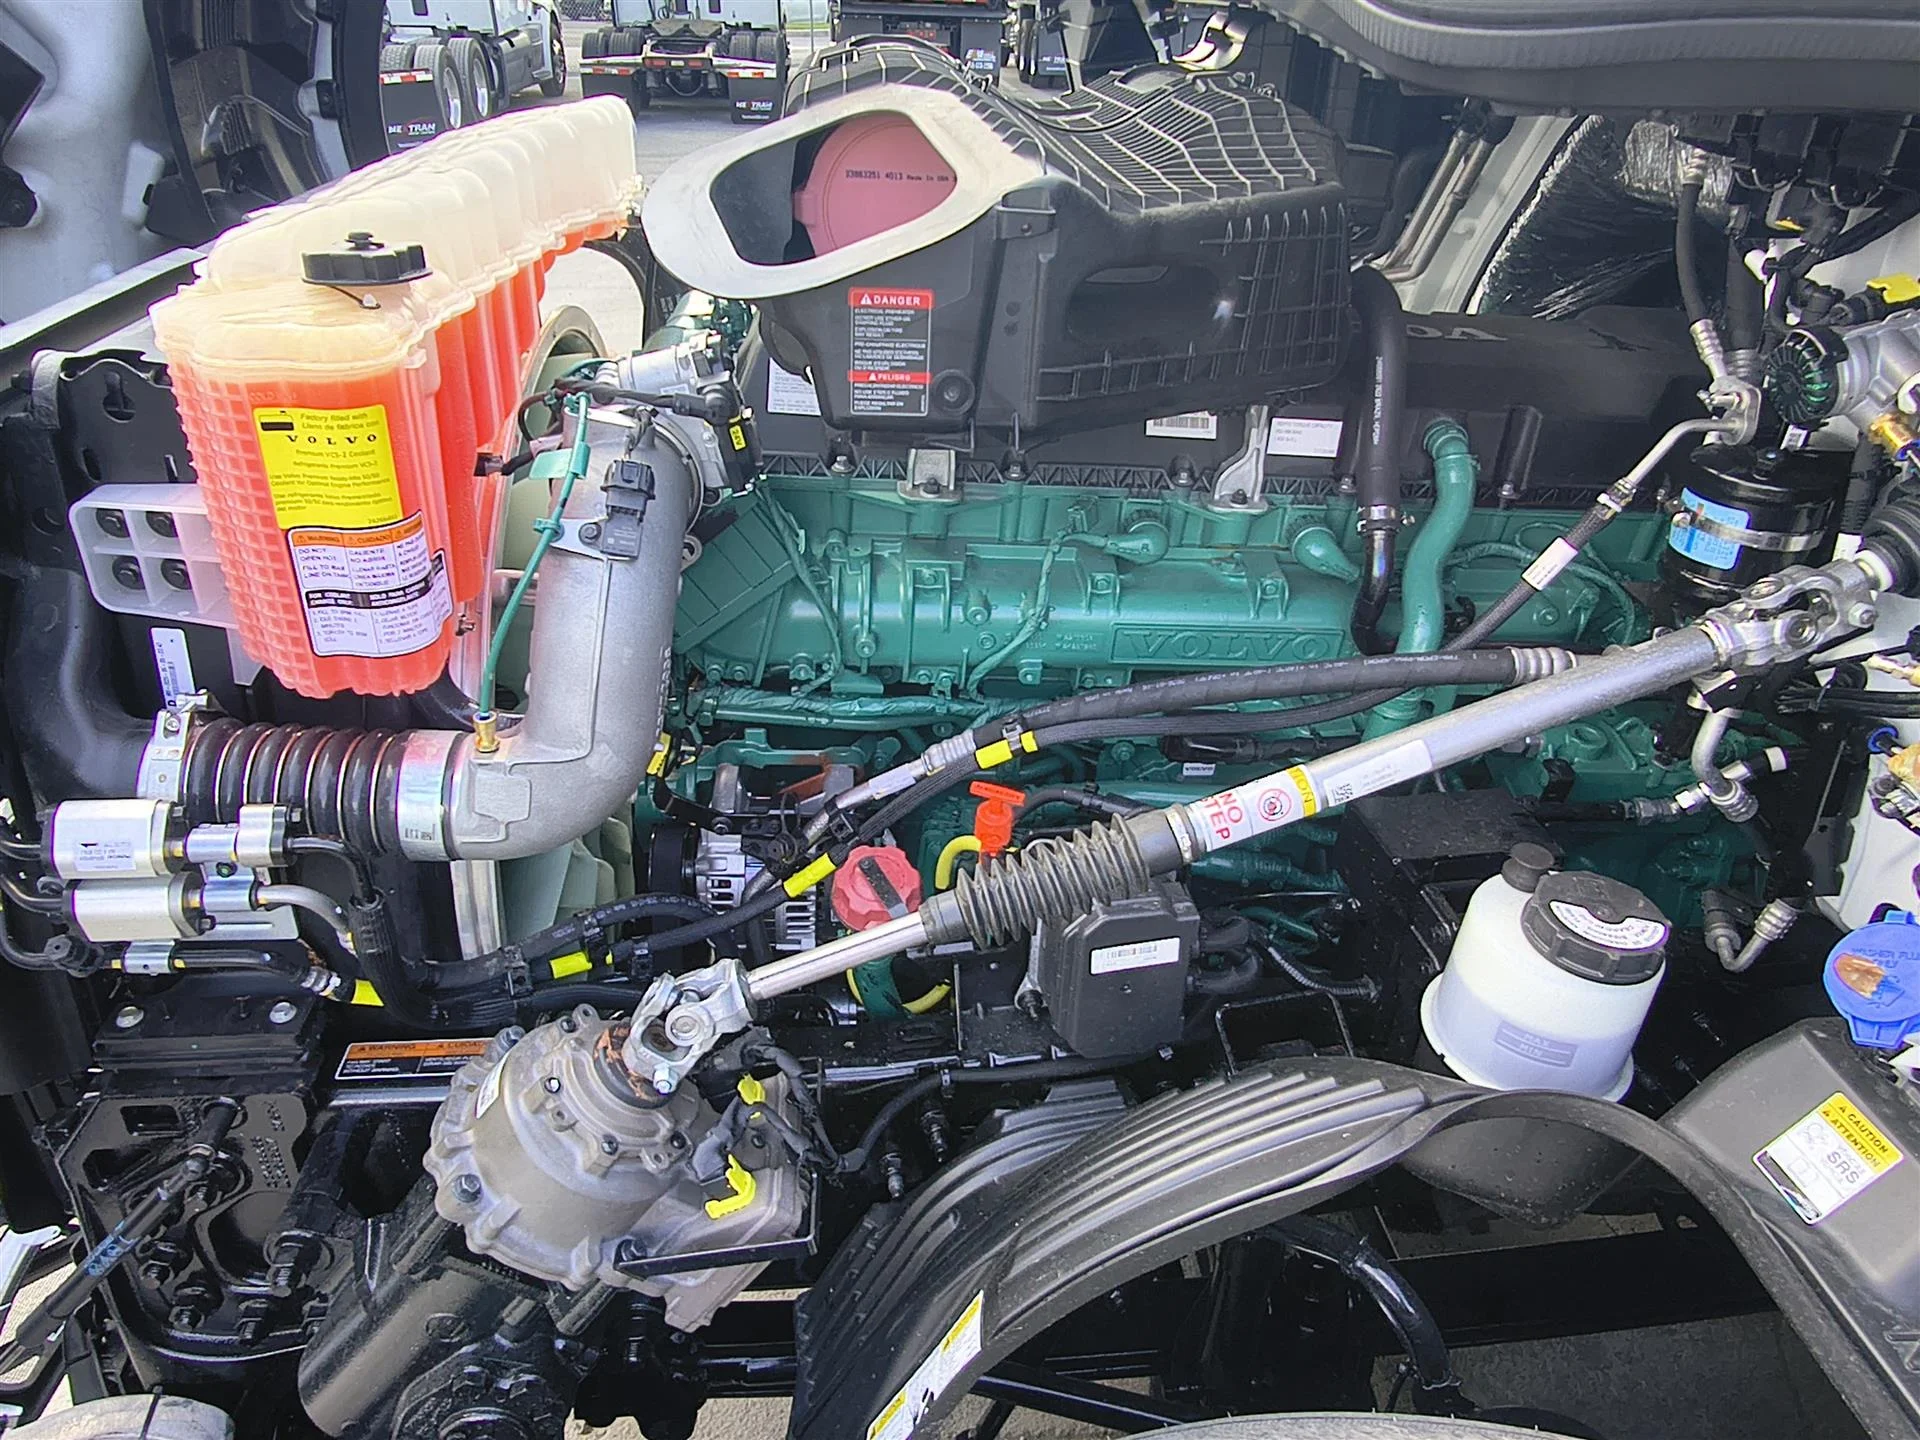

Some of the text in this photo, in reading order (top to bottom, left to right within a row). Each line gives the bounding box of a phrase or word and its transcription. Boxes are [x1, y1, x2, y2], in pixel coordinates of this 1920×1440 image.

[873, 295, 921, 306] DANGER
[877, 373, 911, 381] PELIGRO
[300, 413, 328, 422] Factory
[286, 434, 377, 445] VOLVO
[1124, 630, 1330, 661] VOLVO
[1202, 796, 1231, 840] TEP
[1219, 792, 1243, 824] NO
[1520, 1042, 1543, 1057] MIN
[1525, 1032, 1550, 1046] MAX
[1831, 1119, 1881, 1168] ATTENTION
[1848, 1113, 1888, 1153] CAUTION
[1827, 1151, 1860, 1184] SRS
